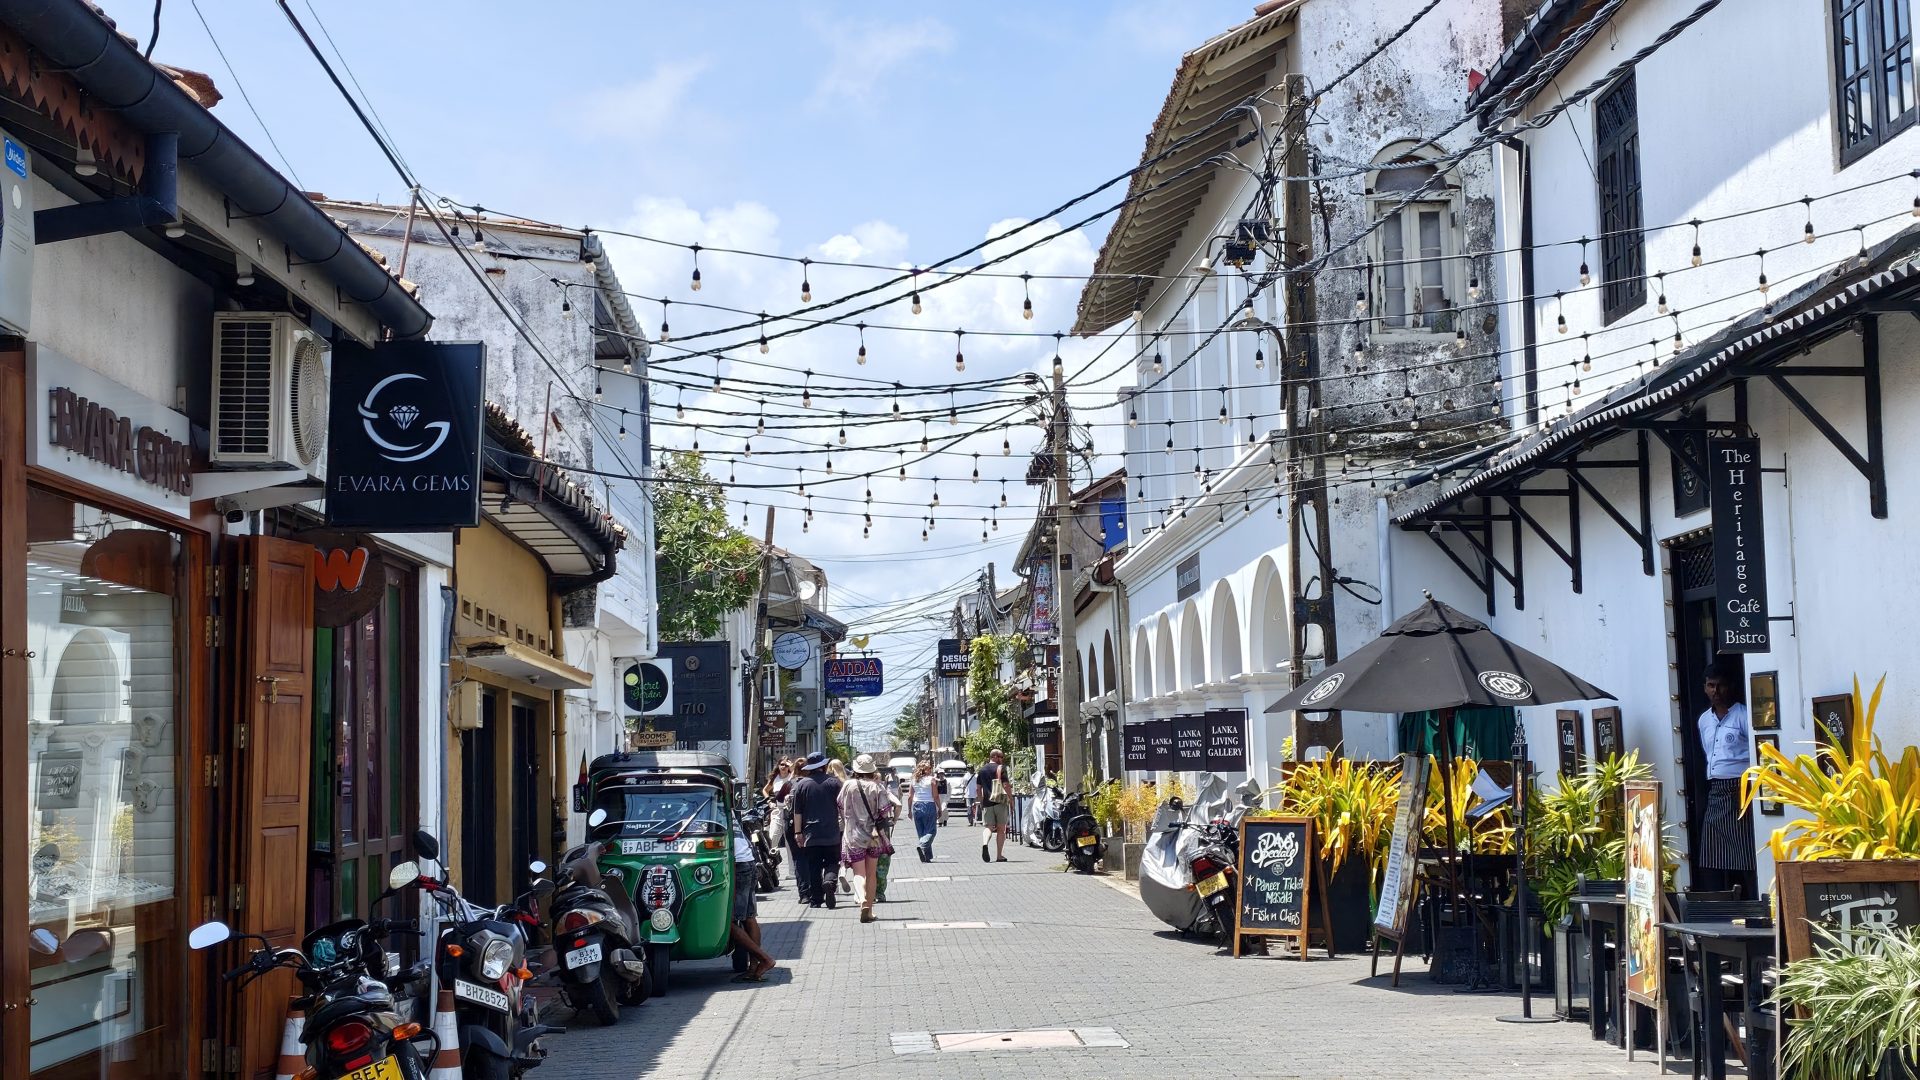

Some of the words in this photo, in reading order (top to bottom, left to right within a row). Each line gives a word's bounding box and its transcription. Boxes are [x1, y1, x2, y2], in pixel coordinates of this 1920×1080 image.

[49, 387, 136, 475] EVARA
[136, 426, 193, 496] GEMS
[1722, 449, 1751, 463] The
[338, 475, 406, 492] EVARA
[412, 475, 470, 491] GEMS
[1728, 469, 1748, 594] Heritage
[1727, 599, 1761, 613] Café
[1739, 617, 1750, 628] &
[1725, 630, 1767, 644] Bistro
[828, 660, 880, 677] AIDA
[680, 702, 706, 714] 1710
[1212, 726, 1238, 734] LANKA
[1212, 737, 1238, 745] LIVING
[1208, 748, 1243, 756] GALLERY
[636, 842, 659, 852] ABF
[664, 841, 694, 852] 8879
[1265, 892, 1292, 904] Masala
[1252, 908, 1270, 921] Fish
[1271, 912, 1277, 920] n
[1280, 909, 1300, 925] Chips
